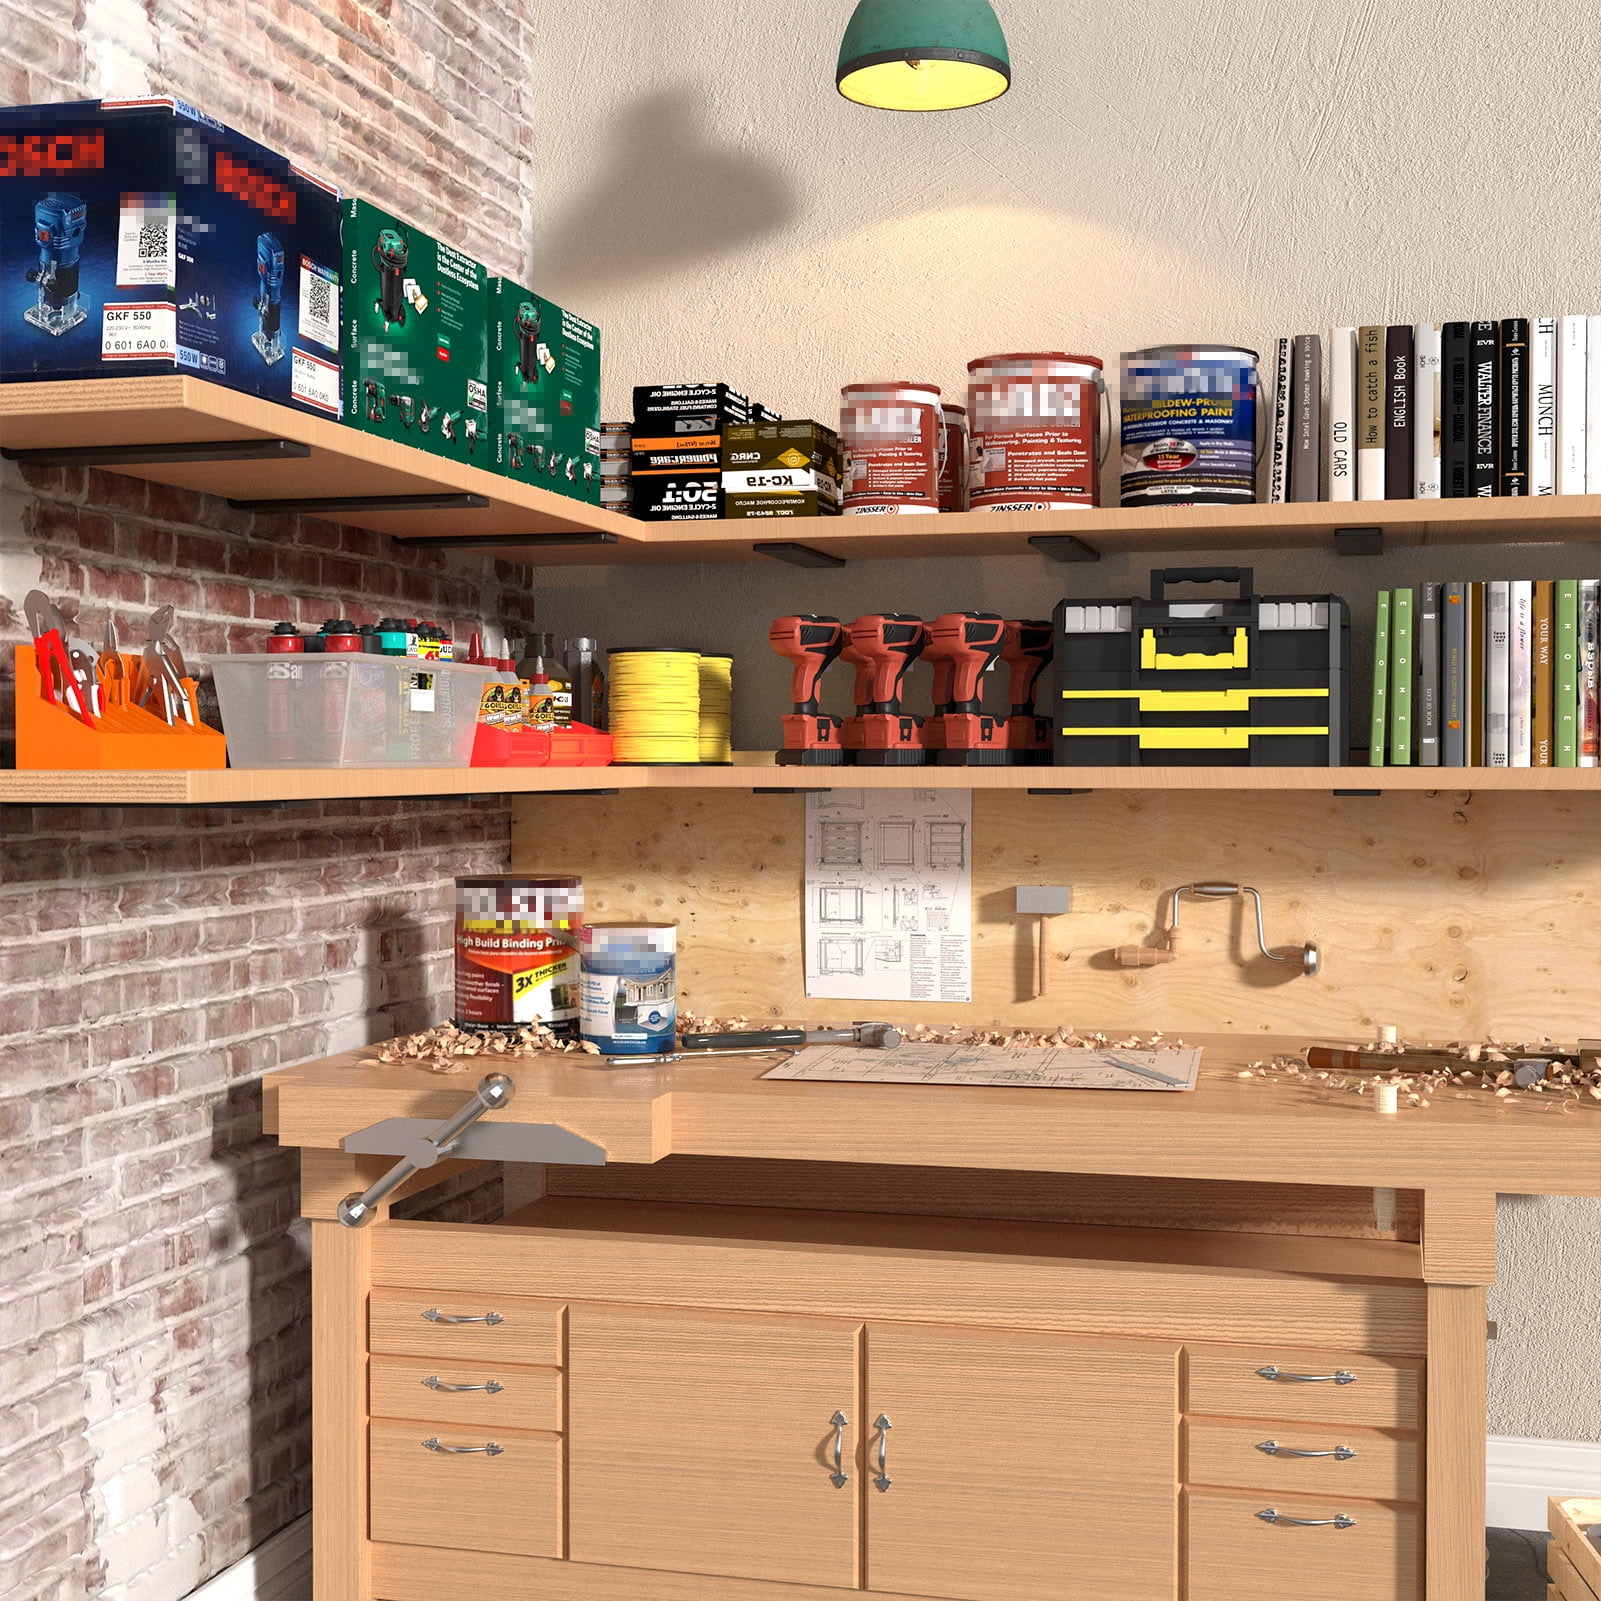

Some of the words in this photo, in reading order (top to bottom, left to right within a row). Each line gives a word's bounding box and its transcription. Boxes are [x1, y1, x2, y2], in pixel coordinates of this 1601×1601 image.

[436, 241, 446, 253] The
[456, 252, 477, 269] Extractor
[450, 259, 465, 273] Center
[437, 262, 457, 280] Dustless
[456, 272, 479, 291] Ecosystem
[106, 311, 130, 321] GKF
[132, 310, 152, 321] 550
[105, 341, 112, 350] 0
[114, 340, 132, 350] 601
[136, 339, 157, 349] 6A0
[351, 319, 359, 349] Surface
[1365, 329, 1378, 353] fish
[179, 349, 199, 364] 550W
[294, 355, 306, 367] GKF
[1393, 355, 1406, 380] Book
[468, 384, 486, 398] OSHA
[1303, 382, 1312, 405] Stephen
[1365, 372, 1378, 401] catch
[1477, 360, 1493, 407] WALTER
[1123, 408, 1198, 423] WATERPROOFING
[1200, 408, 1234, 417] PAINT
[1303, 407, 1311, 421] Gave
[1368, 407, 1378, 420] to
[1393, 385, 1406, 428] ENGLISH
[1538, 384, 1553, 436] MUNCH
[1333, 421, 1347, 443] OLD
[1366, 425, 1378, 443] How
[1477, 407, 1492, 455] FINANCE
[1333, 449, 1347, 478] CARS
[855, 506, 886, 514] ZINSSER
[990, 503, 1033, 512] ZINSSER
[1518, 598, 1527, 610] life
[1518, 627, 1527, 650] flower
[1539, 618, 1549, 644] YOUR
[1539, 644, 1549, 665] WAY
[1539, 739, 1548, 766] YOUR
[457, 934, 474, 948] High
[474, 937, 500, 948] Build
[501, 938, 543, 950] Binding
[515, 974, 533, 994] 3X
[534, 962, 567, 978] THICKER
